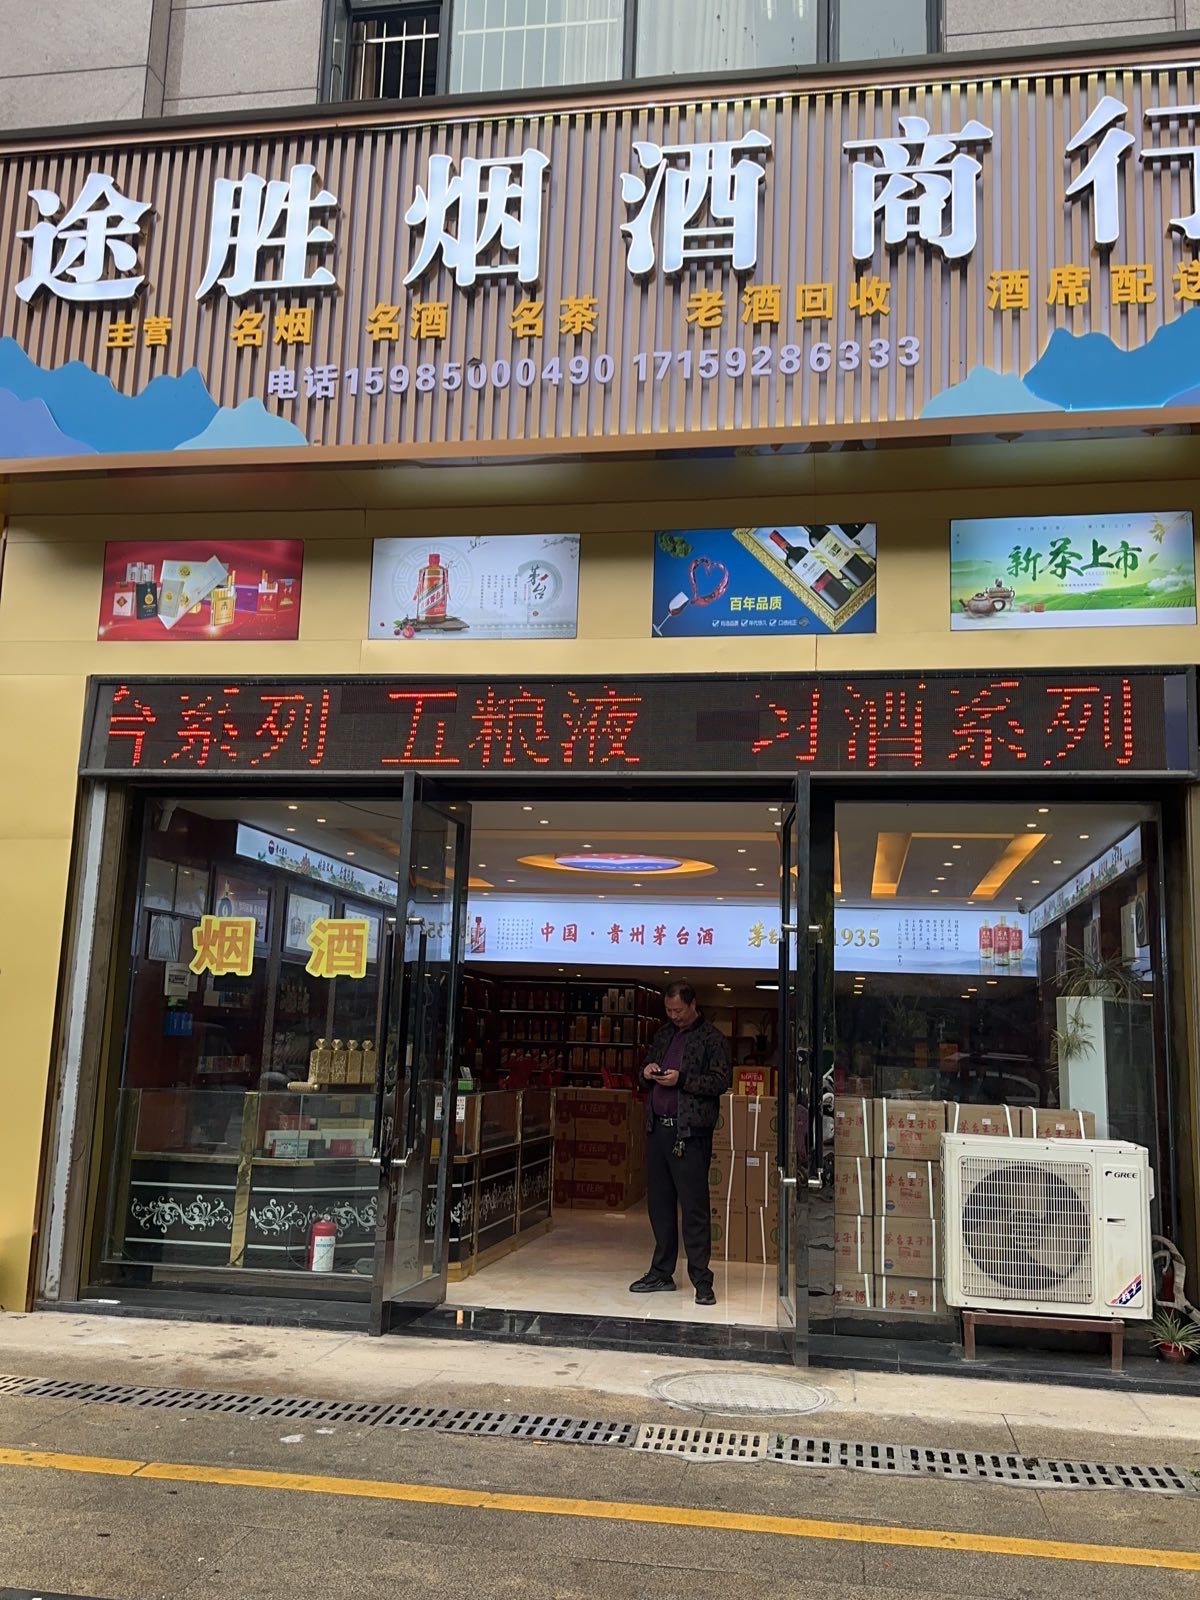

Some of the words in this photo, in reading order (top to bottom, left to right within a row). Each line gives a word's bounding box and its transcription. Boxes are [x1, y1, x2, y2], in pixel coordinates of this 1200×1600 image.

[15, 95, 1200, 302] 途胜烟酒商行
[106, 316, 172, 348] 主营
[230, 306, 313, 347] 名烟
[365, 302, 448, 341] 名酒
[508, 294, 599, 338] 名茶
[686, 276, 891, 328] 老酒回收
[634, 336, 921, 382] 17159286333
[1006, 537, 1143, 582] 新茶上市
[730, 596, 782, 611] 百年品质
[382, 686, 643, 767] 五粮液
[752, 679, 1133, 767] 习酒系列
[189, 915, 256, 976] 烟
[305, 918, 370, 978] 酒
[1114, 1171, 1138, 1179] GREE
